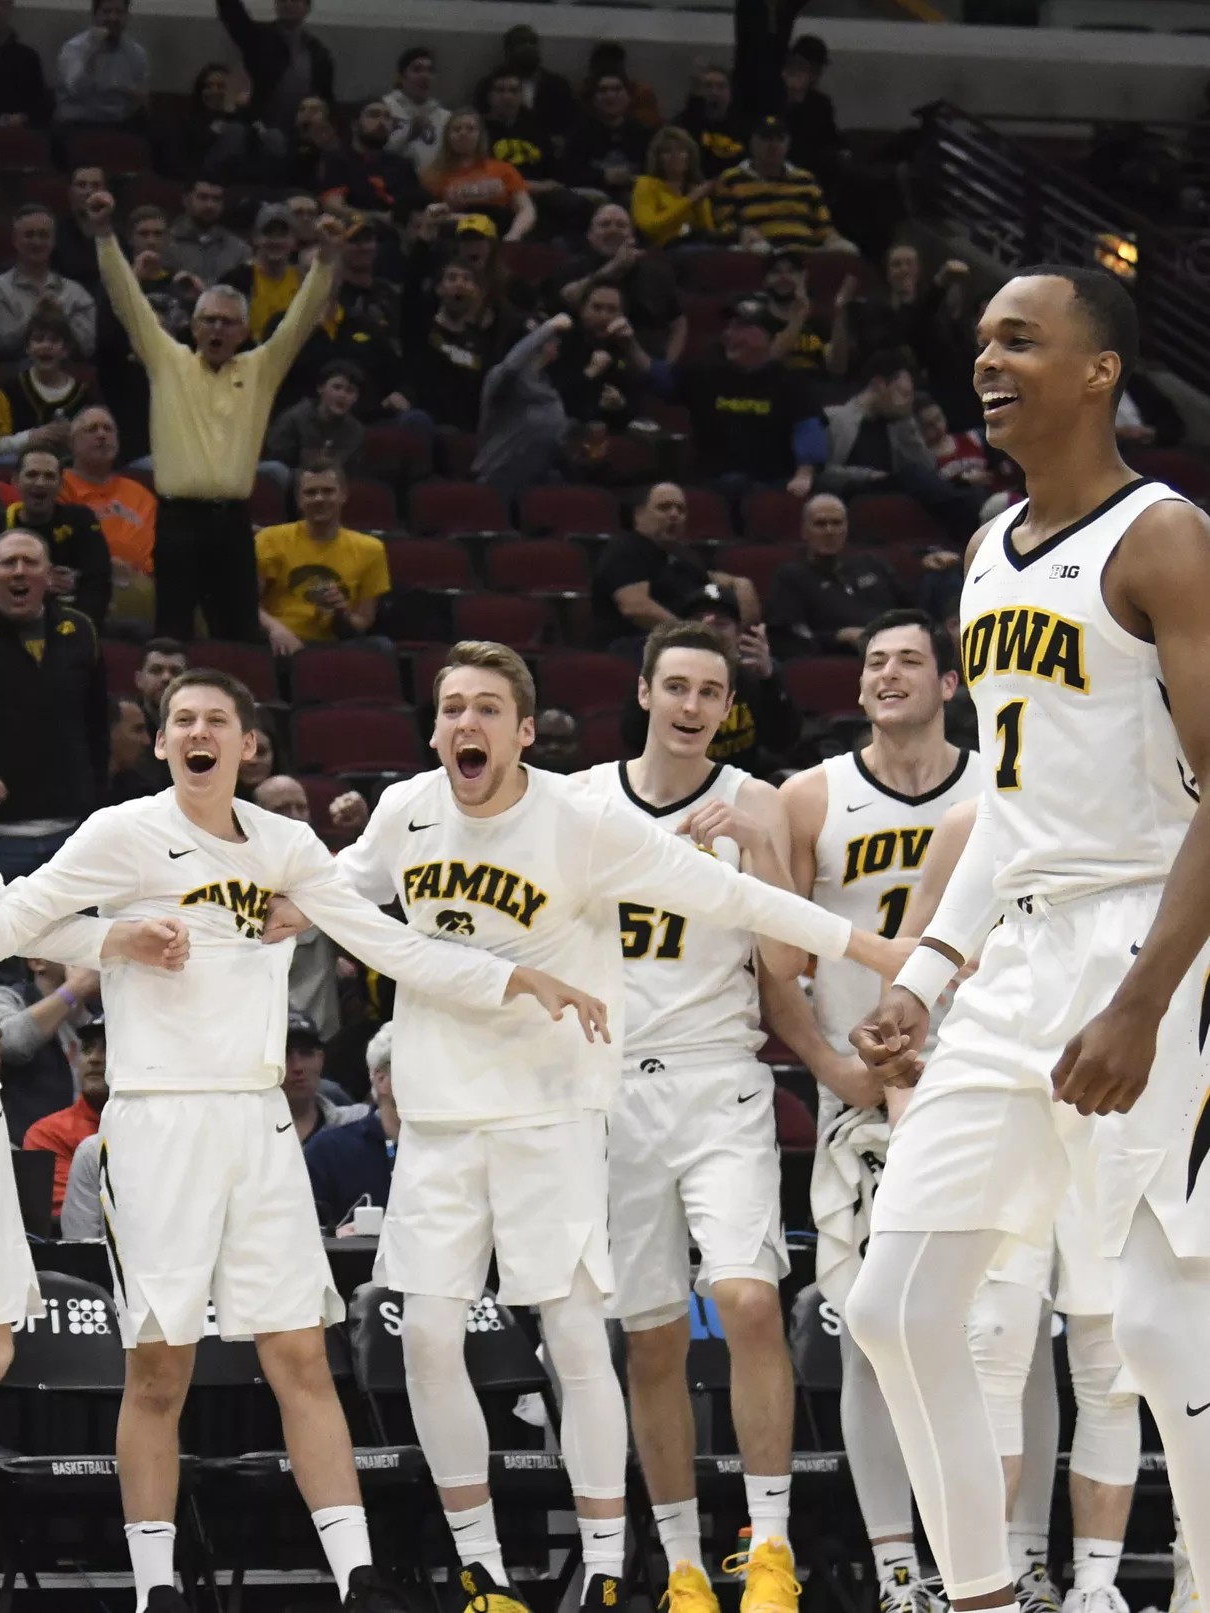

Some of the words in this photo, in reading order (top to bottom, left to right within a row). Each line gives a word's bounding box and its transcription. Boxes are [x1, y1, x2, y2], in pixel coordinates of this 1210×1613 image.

[961, 606, 1090, 695] IOWA
[995, 697, 1029, 792] 1
[842, 827, 935, 887] IOW
[403, 860, 549, 931] FAMILY
[618, 901, 686, 960] 51
[51, 1460, 112, 1475] BASKETBALL
[504, 1455, 558, 1469] BASKETBALL
